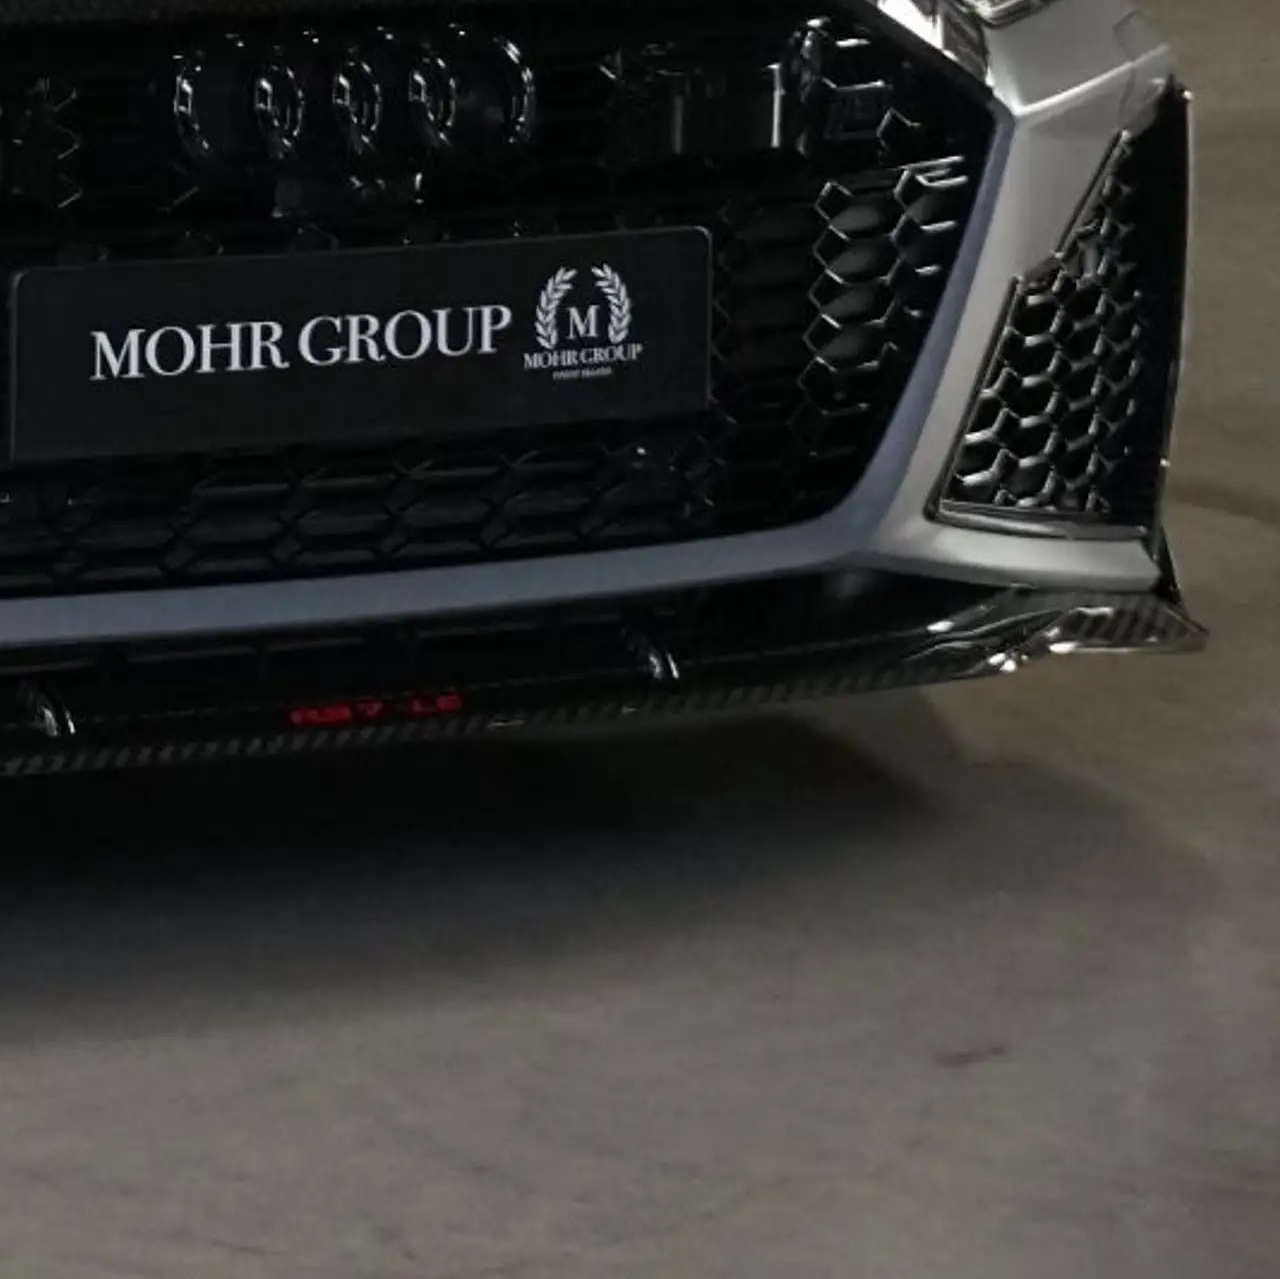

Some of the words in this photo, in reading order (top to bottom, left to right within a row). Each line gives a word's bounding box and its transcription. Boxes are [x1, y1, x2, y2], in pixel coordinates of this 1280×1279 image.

[565, 304, 601, 340] M
[89, 320, 289, 381] MOHR
[298, 304, 512, 365] GROUP
[523, 350, 579, 370] MOHR
[580, 344, 643, 364] GROUP
